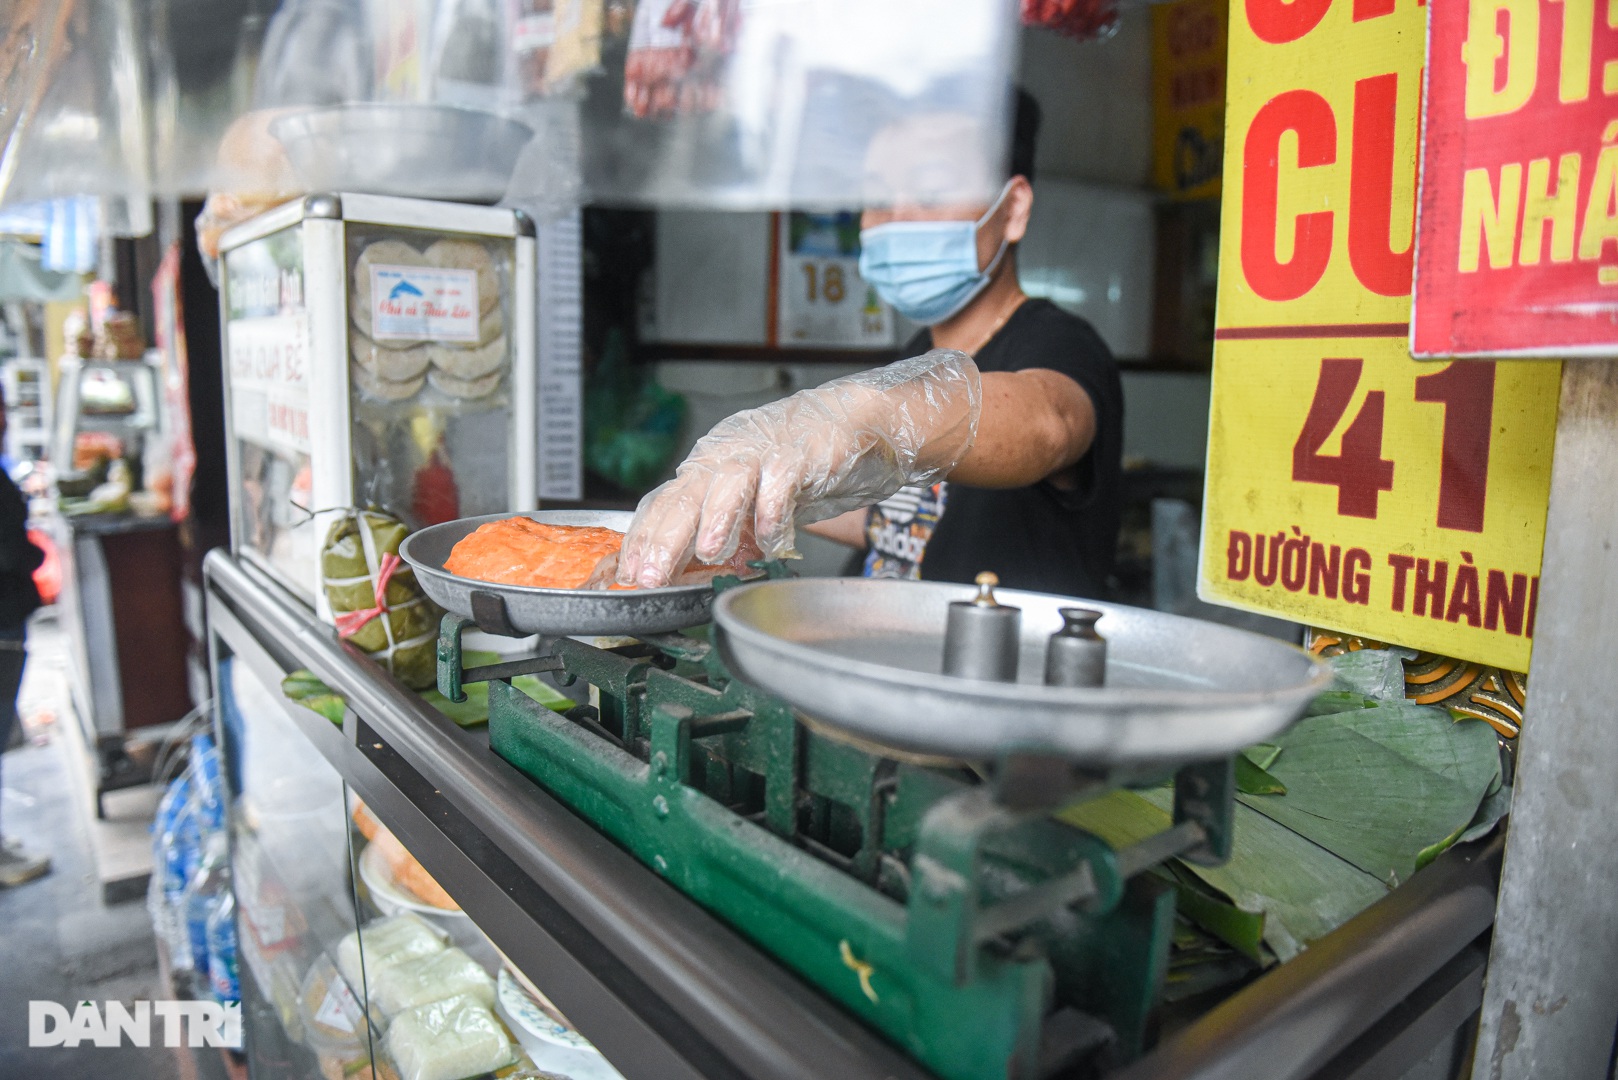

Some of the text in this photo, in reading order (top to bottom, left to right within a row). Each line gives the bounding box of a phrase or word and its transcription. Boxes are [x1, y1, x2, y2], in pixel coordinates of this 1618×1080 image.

[803, 263, 846, 304] 18
[1292, 358, 1496, 533] 41
[1227, 525, 1372, 605] ĐƯỜNG
